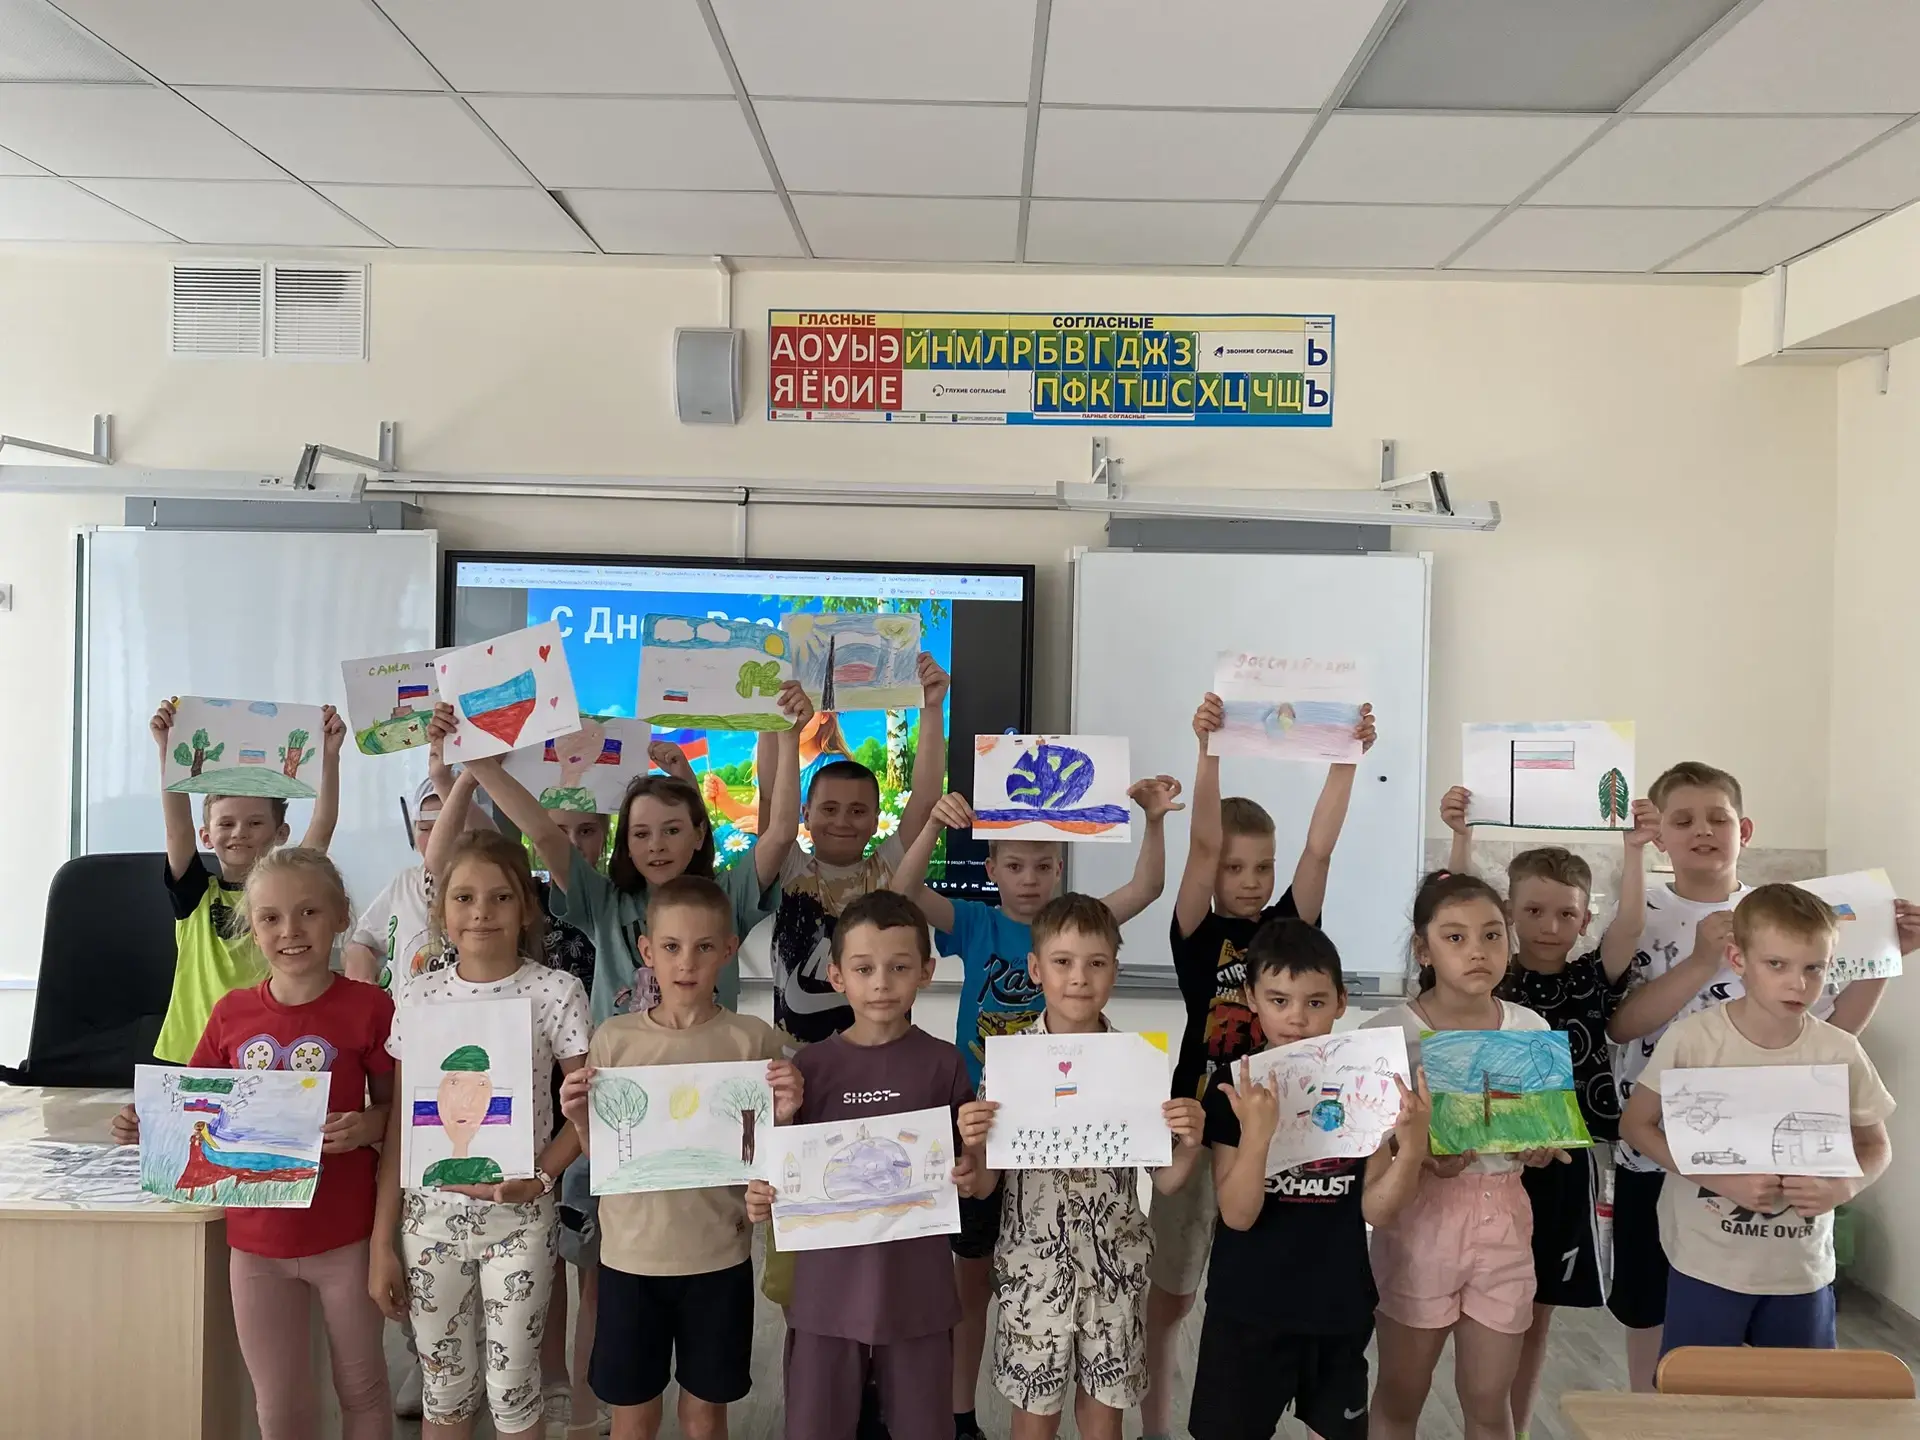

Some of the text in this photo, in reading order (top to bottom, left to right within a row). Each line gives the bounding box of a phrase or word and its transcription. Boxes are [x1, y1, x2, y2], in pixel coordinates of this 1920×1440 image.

[799, 313, 876, 326] ГЛАСНЫЕ
[1052, 316, 1154, 329] СОГЛАСНЫЕ
[1721, 1219, 1814, 1239] GAME OVER
